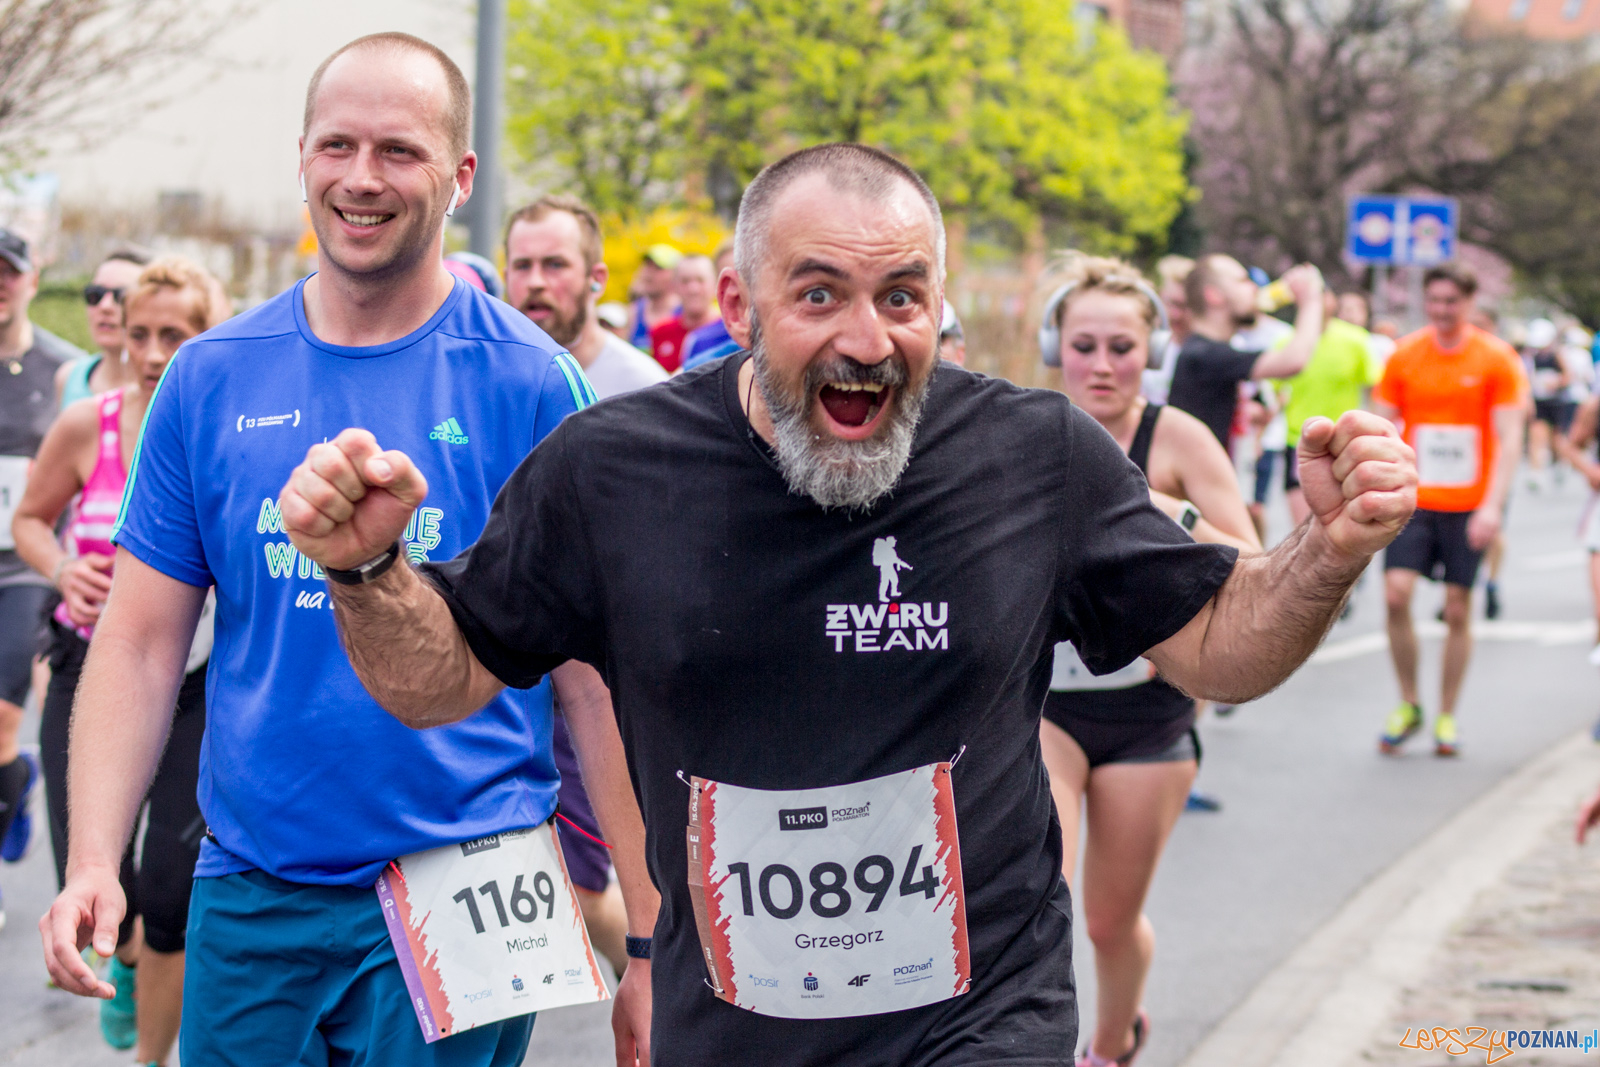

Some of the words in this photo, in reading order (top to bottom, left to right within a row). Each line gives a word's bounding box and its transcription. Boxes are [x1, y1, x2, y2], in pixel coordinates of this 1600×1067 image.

[429, 431, 469, 445] adidas
[825, 628, 948, 652] TEAM
[727, 844, 940, 920] 10894
[452, 870, 555, 934] 1169
[506, 933, 549, 953] Michał
[795, 930, 884, 950] Grzegorz
[847, 974, 871, 987] 4F
